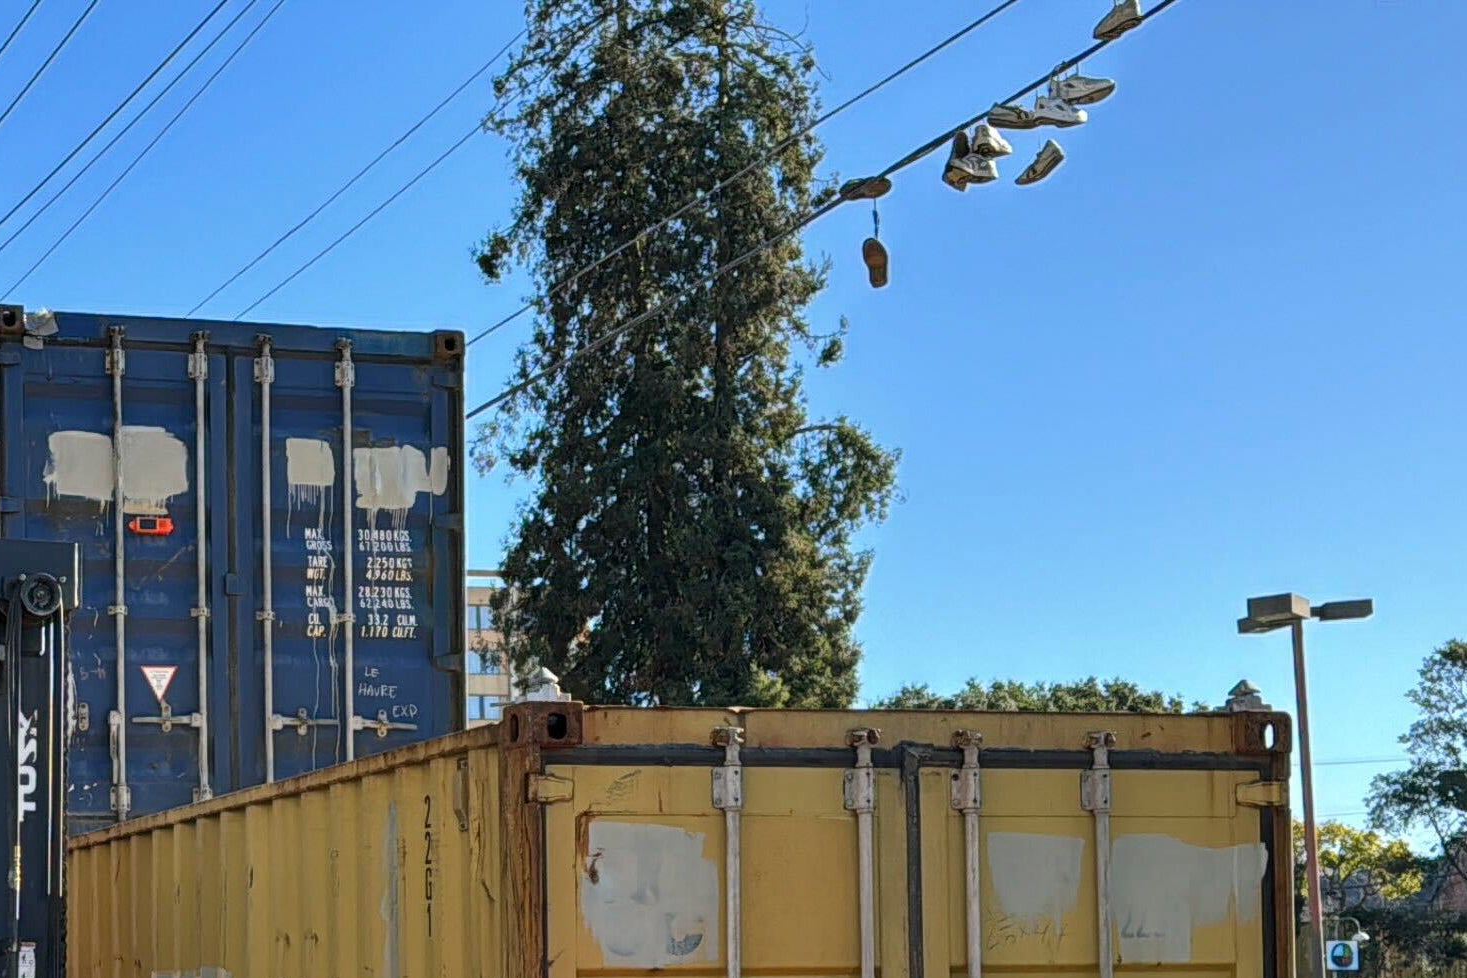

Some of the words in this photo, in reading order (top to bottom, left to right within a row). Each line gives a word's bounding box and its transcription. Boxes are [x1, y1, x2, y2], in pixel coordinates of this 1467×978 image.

[306, 541, 333, 552] GROSS
[307, 556, 329, 568] TARE
[306, 568, 326, 580] WGT.
[305, 585, 326, 598] MAX.
[367, 613, 389, 626] 33.2
[306, 625, 327, 637] CAP.
[364, 664, 380, 678] LE
